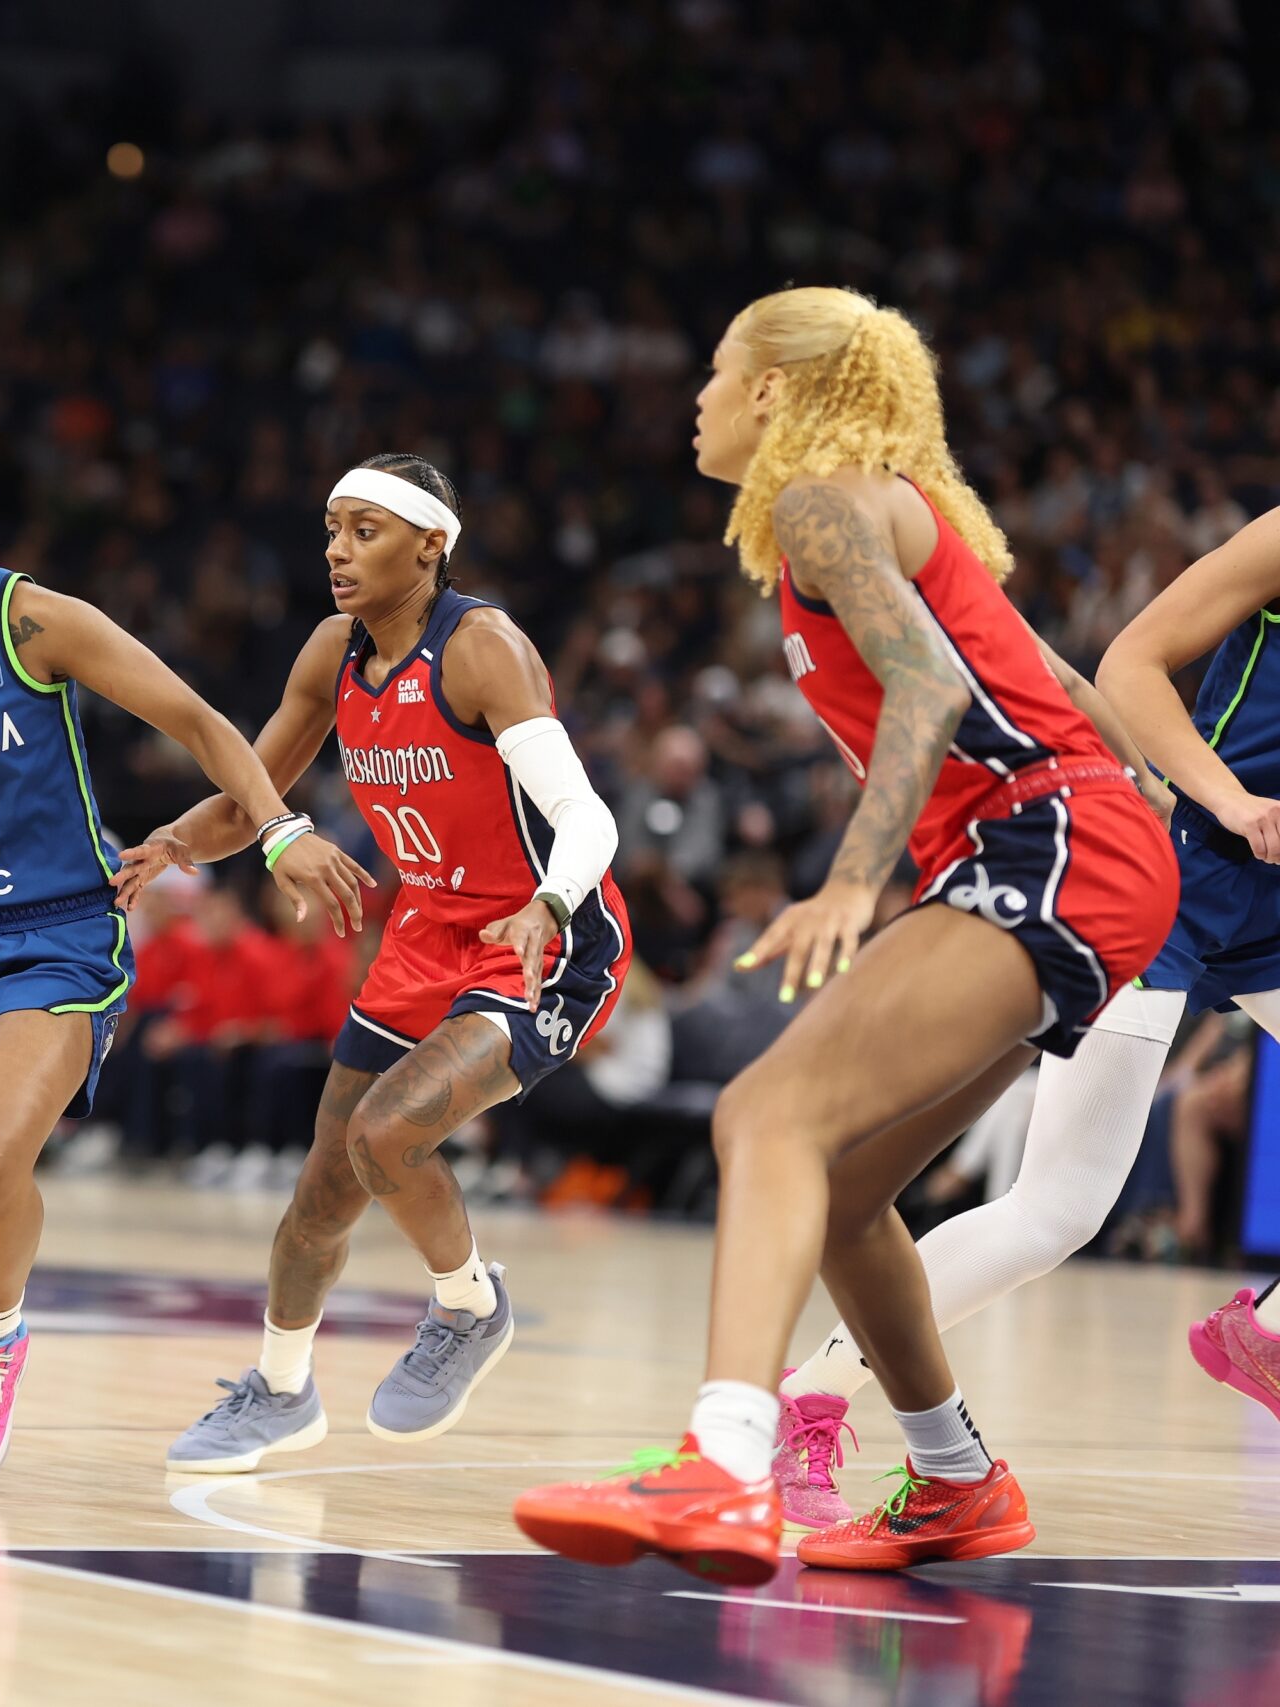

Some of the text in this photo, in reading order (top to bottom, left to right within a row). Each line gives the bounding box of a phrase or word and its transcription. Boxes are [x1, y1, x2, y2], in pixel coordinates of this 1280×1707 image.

[397, 678, 419, 692] CAR
[398, 690, 426, 704] max
[371, 803, 443, 864] 20
